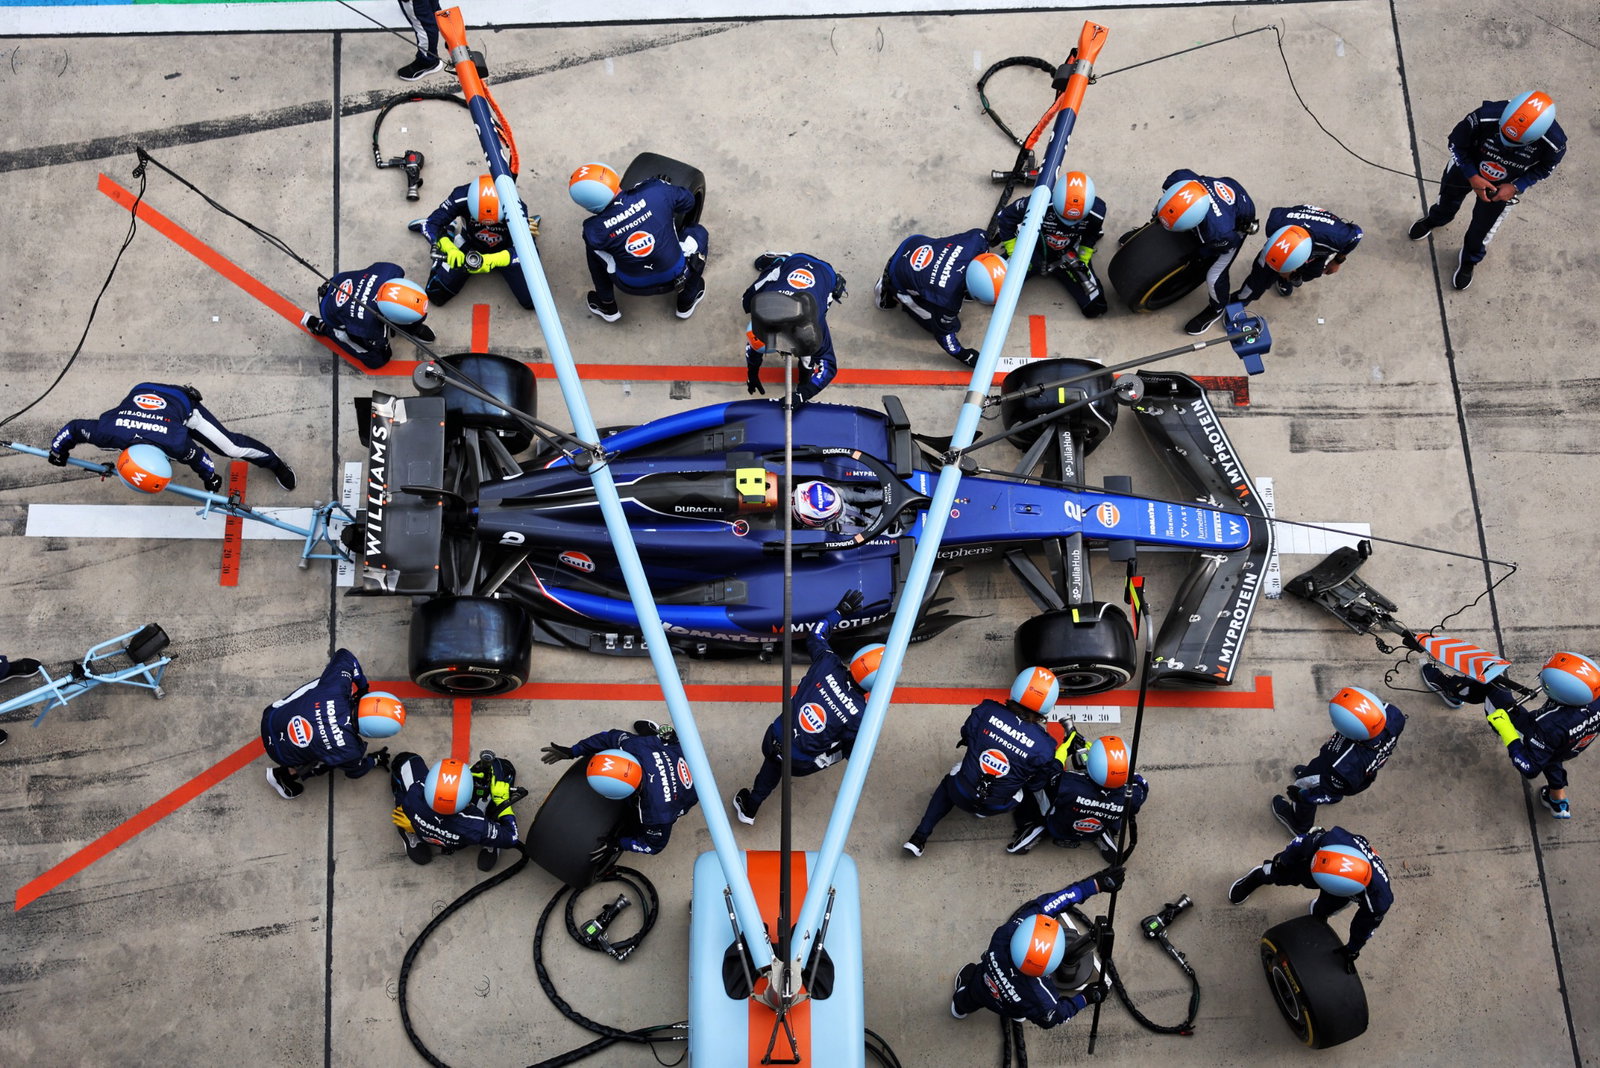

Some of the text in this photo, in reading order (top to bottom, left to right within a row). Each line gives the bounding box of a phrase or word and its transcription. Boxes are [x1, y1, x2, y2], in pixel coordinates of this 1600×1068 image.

[1481, 163, 1507, 178] Gulf
[603, 198, 647, 229] KOMATSU
[615, 210, 653, 236] MYPROTEIN
[1287, 212, 1335, 226] KOMATSU
[626, 236, 654, 253] Gulf
[914, 246, 930, 269] Gulf
[929, 247, 949, 285] MYPROTEIN
[938, 245, 964, 288] KOMATSU
[788, 272, 814, 285] Gulf
[115, 418, 168, 435] KOMATSU
[118, 410, 164, 422] MYPROTEIN
[1063, 431, 1072, 465] JuliaHub
[1191, 400, 1242, 485] MYPROTEIN
[344, 488, 352, 499] 20
[366, 425, 388, 556] WILLIAMS
[1265, 488, 1272, 498] 30
[674, 505, 724, 513] DURACELL
[1064, 500, 1082, 523] 2
[1104, 502, 1114, 526] Gulf
[1148, 503, 1156, 535] KOMATSU
[1229, 520, 1240, 536] W
[224, 548, 232, 558] 20
[825, 540, 854, 548] DURACELL
[937, 546, 993, 559] tephens
[223, 563, 231, 574] 30
[339, 565, 347, 575] 30
[560, 555, 594, 572] Gulf
[1071, 550, 1081, 591] JuliaHub
[1272, 578, 1280, 588] 30
[1219, 572, 1258, 664] MYPROTEIN
[819, 688, 849, 724] MYPROTEIN
[824, 673, 860, 716] KOMATSU
[314, 709, 333, 750] MYPROTEIN
[326, 700, 346, 748] KOMATSU
[801, 705, 824, 731] Gulf
[292, 717, 308, 746] Gulf
[988, 715, 1035, 748] KOMATSU
[988, 732, 1029, 759] MYPROTEIN
[662, 751, 678, 793] MYPROTEIN
[981, 753, 1009, 774] Gulf
[442, 773, 457, 785] W
[652, 751, 672, 803] KOMATSU
[1076, 795, 1124, 813] KOMATSU
[414, 813, 460, 841] KOMATSU
[989, 951, 1022, 1003] KOMATSU
